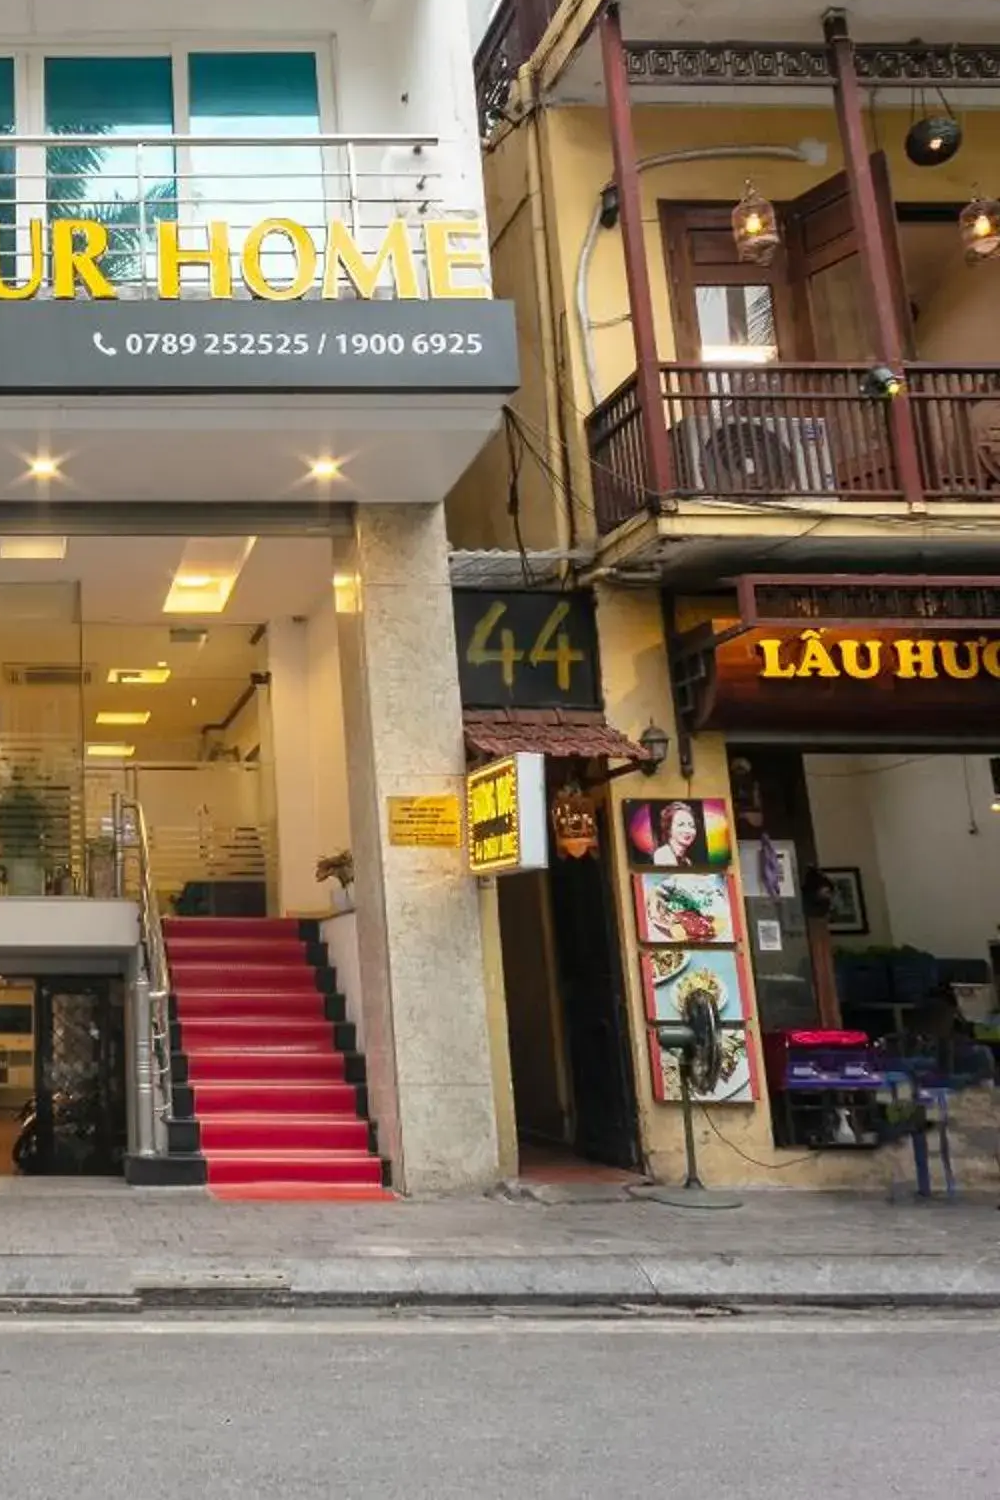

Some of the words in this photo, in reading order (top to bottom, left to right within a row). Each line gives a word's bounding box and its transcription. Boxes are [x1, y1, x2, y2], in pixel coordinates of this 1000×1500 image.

[154, 217, 494, 301] HOME
[125, 332, 197, 356] 0789
[204, 332, 310, 356] 252525
[335, 332, 405, 356] 1900
[411, 332, 484, 356] 6925
[466, 600, 584, 692] 44
